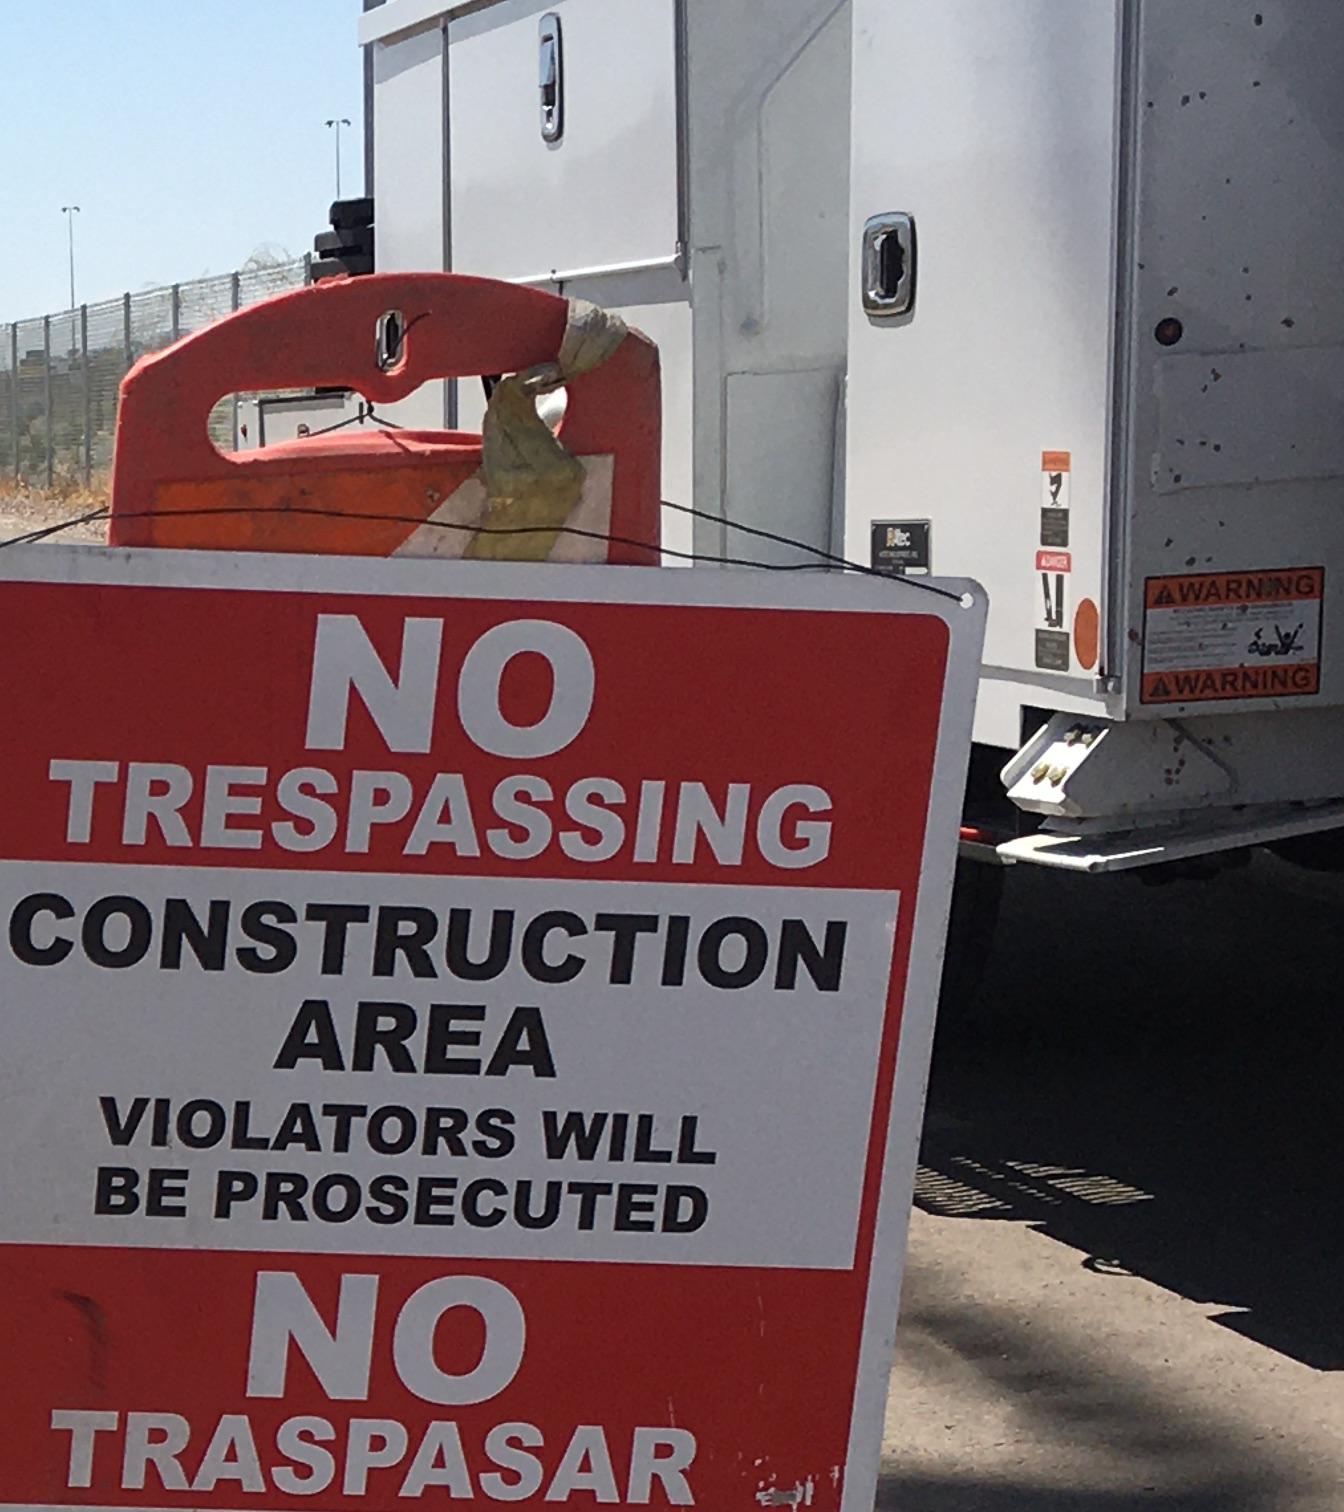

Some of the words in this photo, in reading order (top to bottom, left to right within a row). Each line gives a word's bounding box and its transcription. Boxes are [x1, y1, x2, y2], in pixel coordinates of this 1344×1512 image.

[1178, 573, 1315, 602] WARNING
[304, 613, 596, 759] NO
[1174, 667, 1311, 695] WARNING
[48, 758, 833, 869] TRESPASSING
[8, 892, 848, 993] CONSTRUCTION
[272, 998, 557, 1079] AREA
[98, 1095, 516, 1159] VIOLATORS
[541, 1110, 717, 1165] WILL
[93, 1166, 190, 1218] BE
[213, 1169, 709, 1234] PROSECUTED
[245, 1270, 526, 1406] NO
[50, 1409, 697, 1506] TRASPASAR
